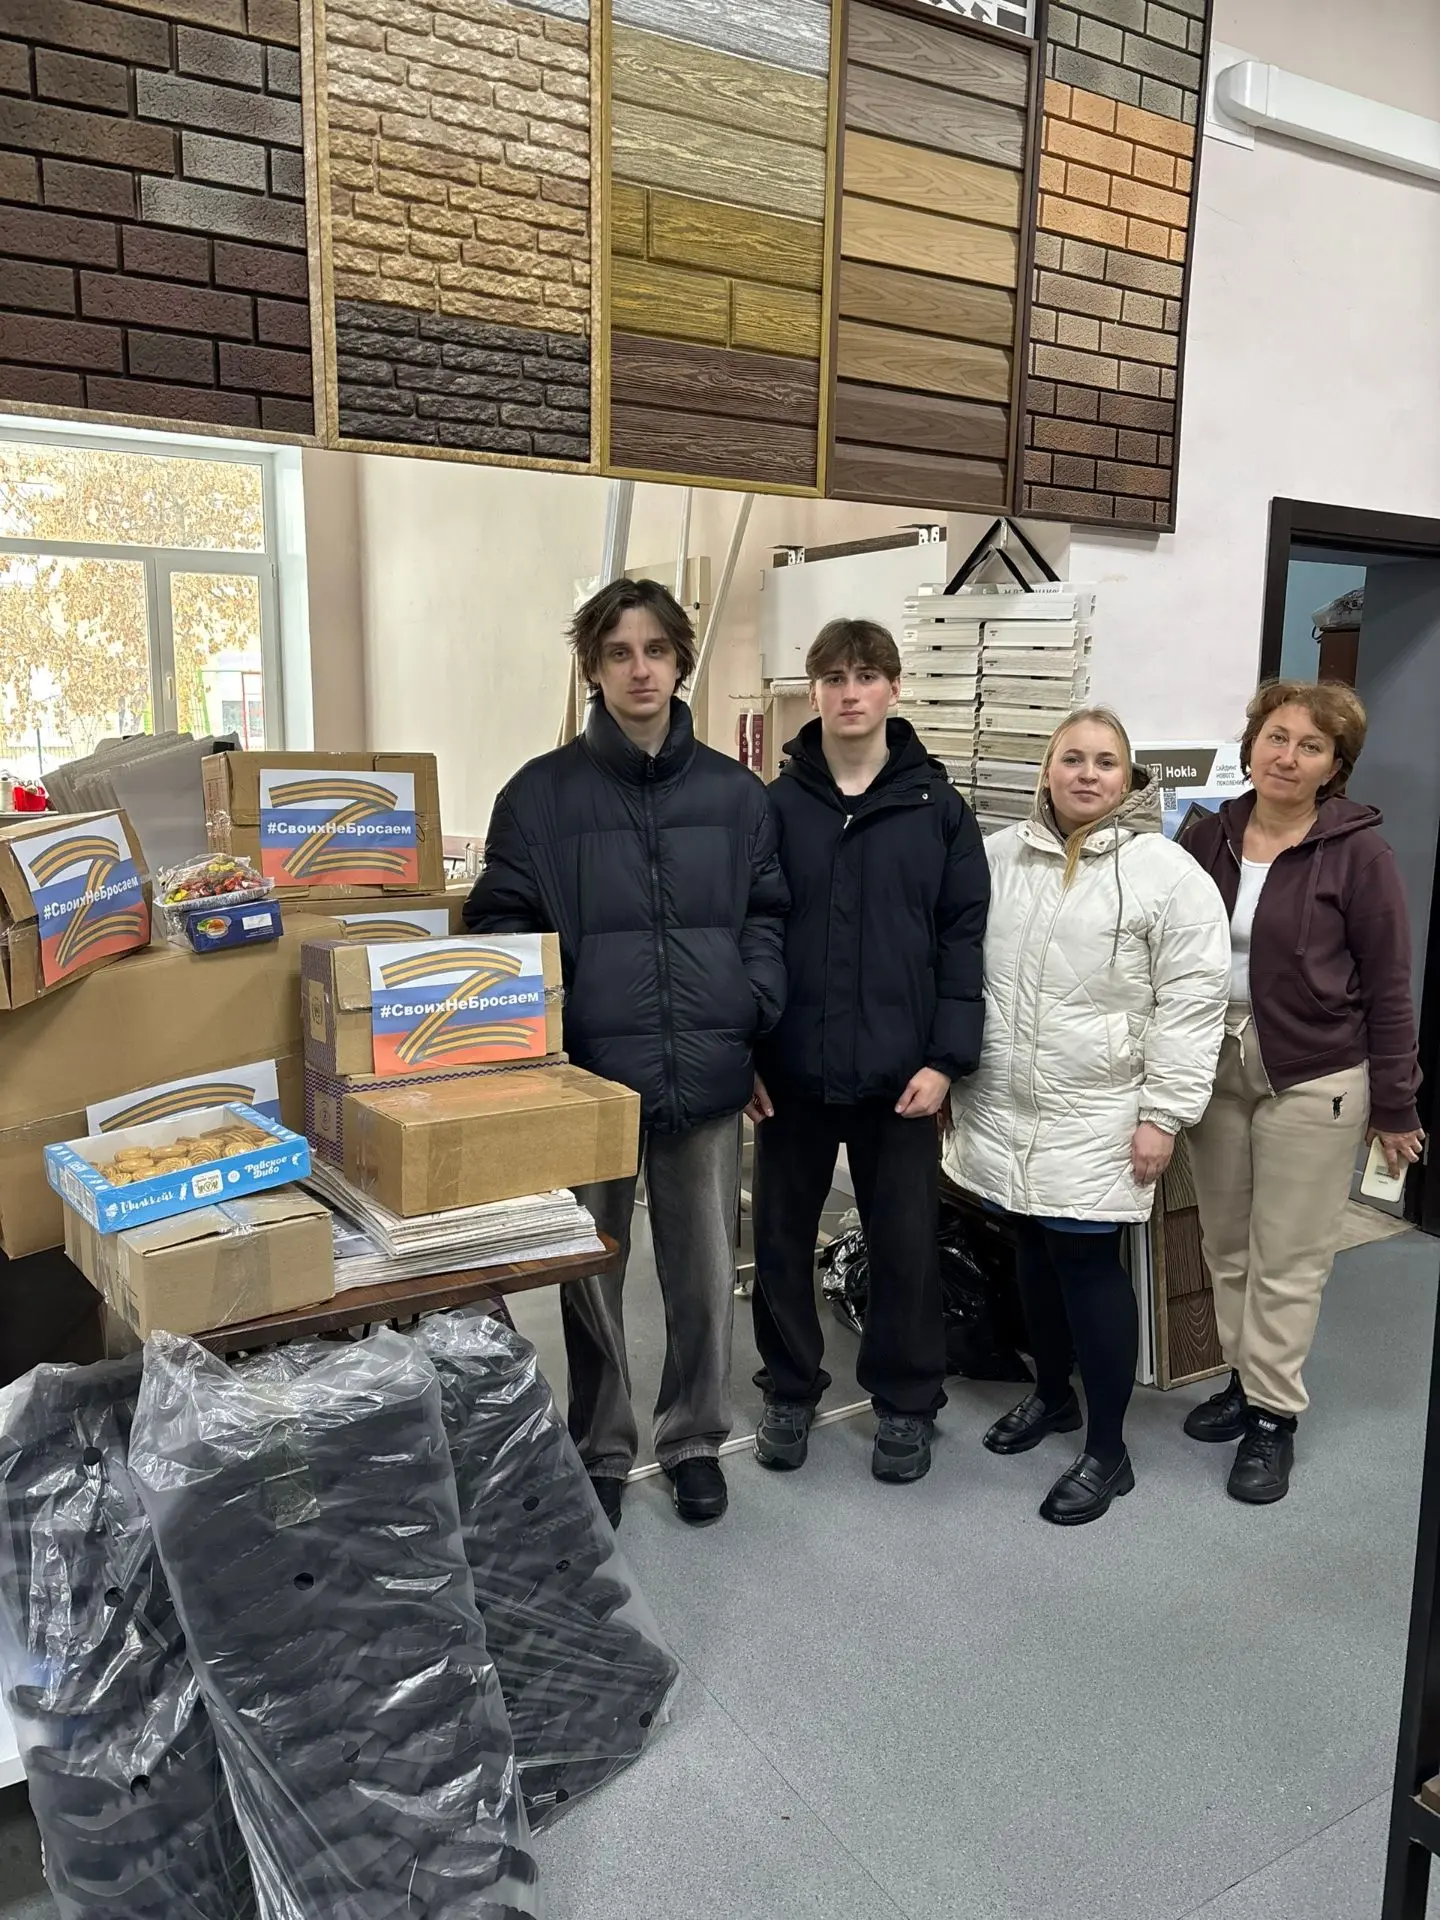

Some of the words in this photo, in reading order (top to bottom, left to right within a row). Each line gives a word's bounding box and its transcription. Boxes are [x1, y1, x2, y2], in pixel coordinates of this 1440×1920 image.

[1166, 765, 1197, 778] Hokla
[267, 822, 412, 836] #СвоихНеБросаем
[43, 876, 139, 920] #СвоихНеБросаем
[380, 991, 539, 1018] #СвоихНеБросаем
[244, 1156, 288, 1173] Райское
[252, 1166, 280, 1179] Диво
